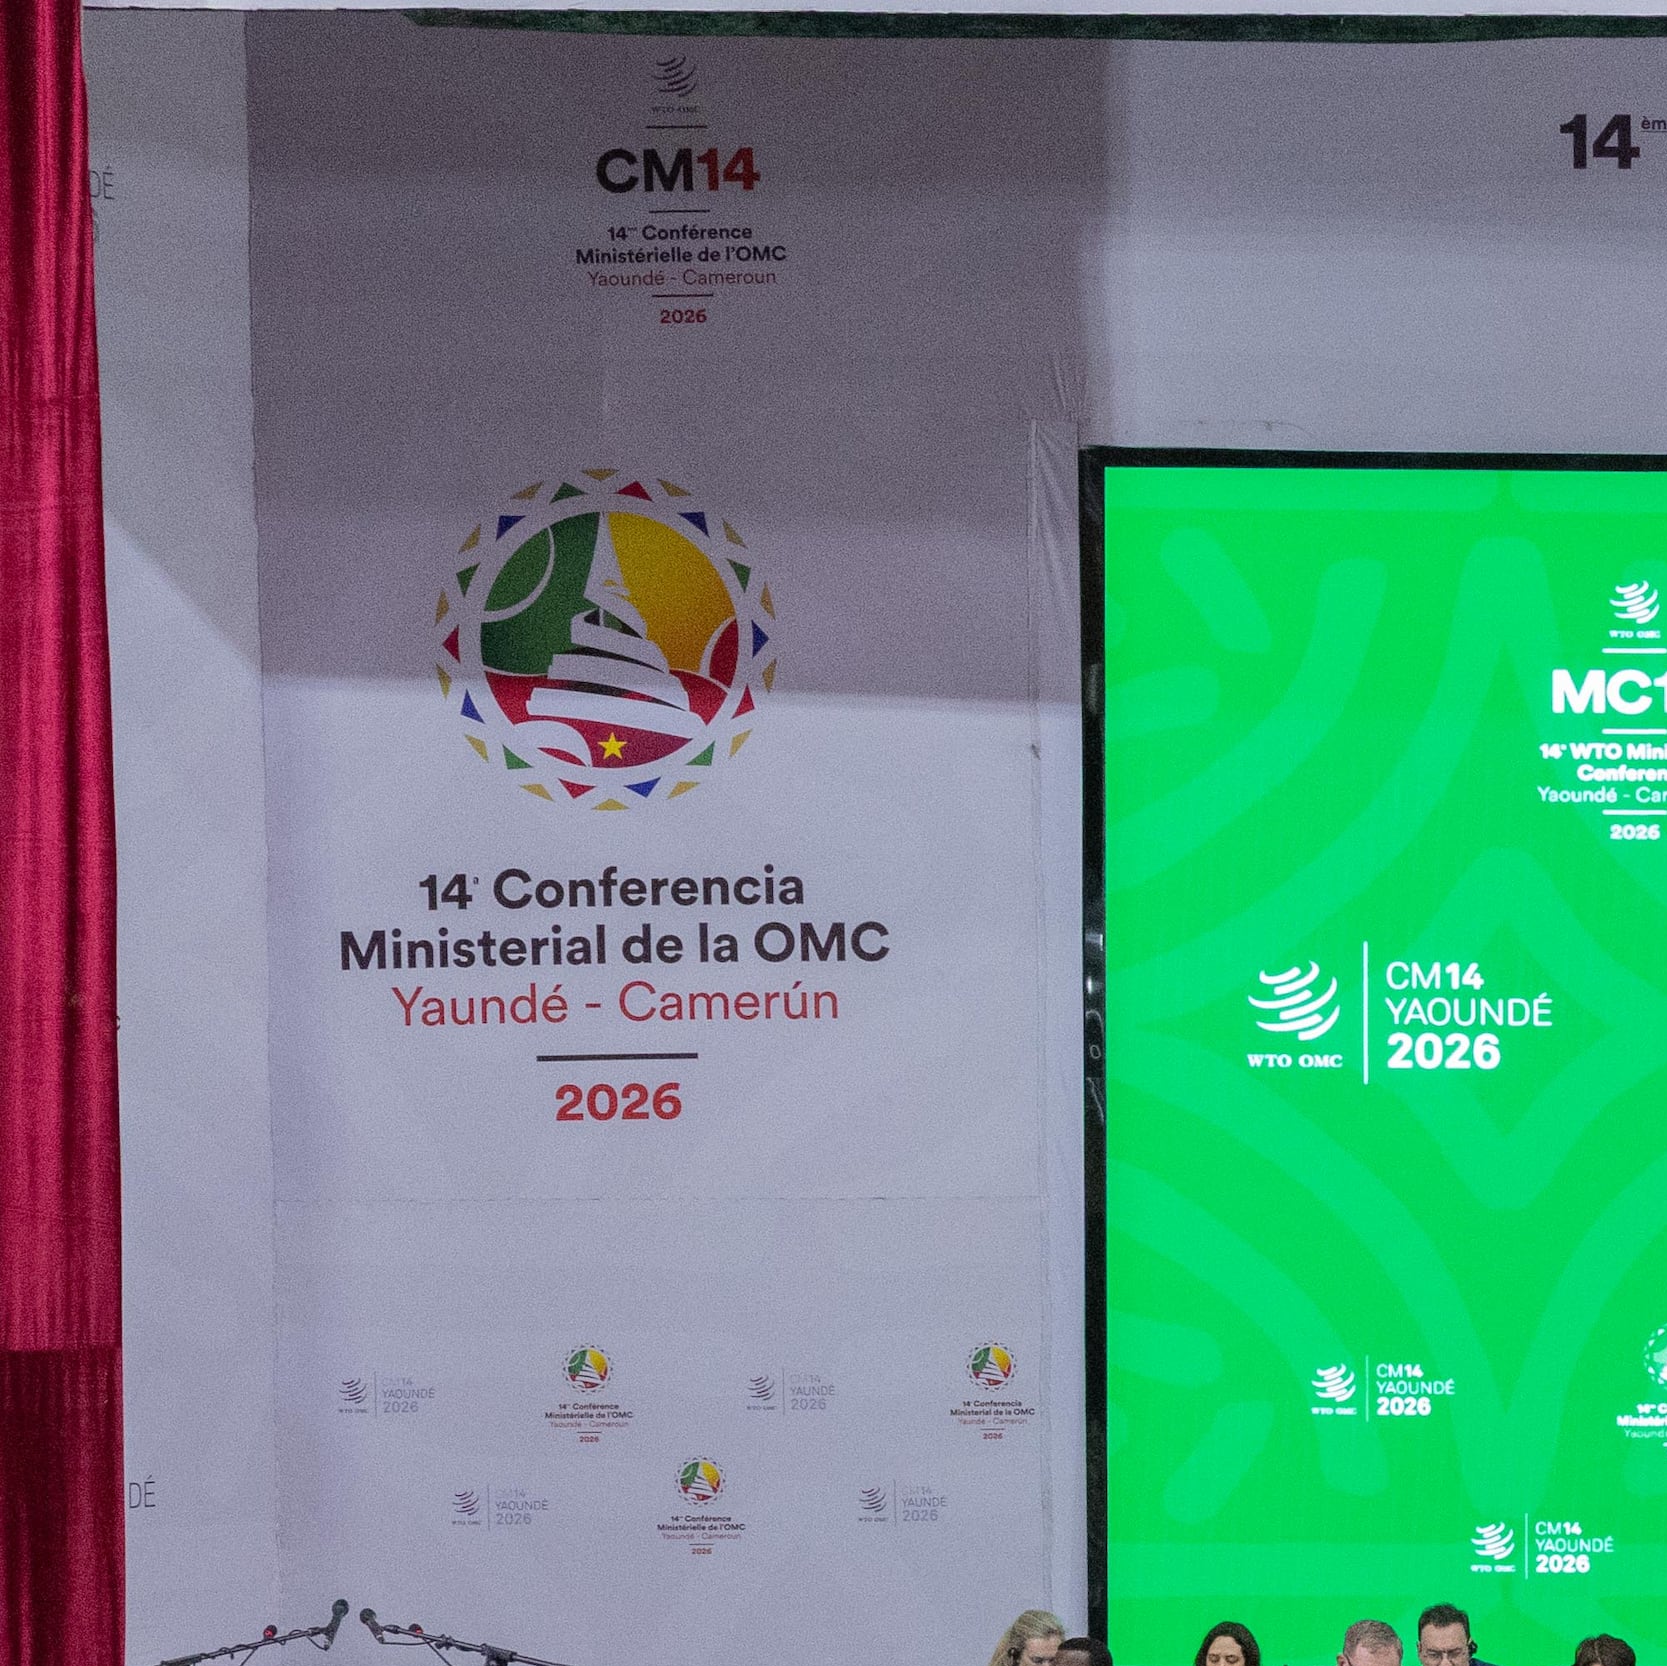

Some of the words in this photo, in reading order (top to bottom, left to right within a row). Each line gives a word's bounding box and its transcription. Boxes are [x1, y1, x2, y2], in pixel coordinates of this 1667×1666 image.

[597, 148, 760, 193] CM14
[642, 226, 752, 240] Conférence
[576, 248, 692, 264] Ministérielle
[698, 248, 720, 262] de
[726, 246, 786, 261] l'OMC
[588, 270, 665, 286] Yaoundé
[682, 269, 777, 285] Cameroun
[661, 309, 707, 323] 2026
[1570, 743, 1622, 759] WTO
[1538, 787, 1617, 803] Yaoundé
[1611, 825, 1660, 839] 2026
[494, 865, 803, 909] Conferencia
[341, 925, 605, 970] Ministerial
[623, 924, 683, 963] de
[700, 923, 738, 962] la
[755, 922, 889, 962] OMC
[1387, 962, 1484, 989] CM14
[392, 983, 567, 1026] Yaundé
[619, 981, 837, 1021] Camerún
[1386, 993, 1551, 1026] YAOUNDÉ
[1388, 1033, 1500, 1069] 2026
[1248, 1054, 1292, 1067] WTO
[1299, 1055, 1342, 1067] OMC
[556, 1083, 681, 1121] 2026
[1377, 1364, 1423, 1377] CM14
[1377, 1379, 1454, 1397] YAOUNDÉ
[1378, 1397, 1431, 1415] 2026
